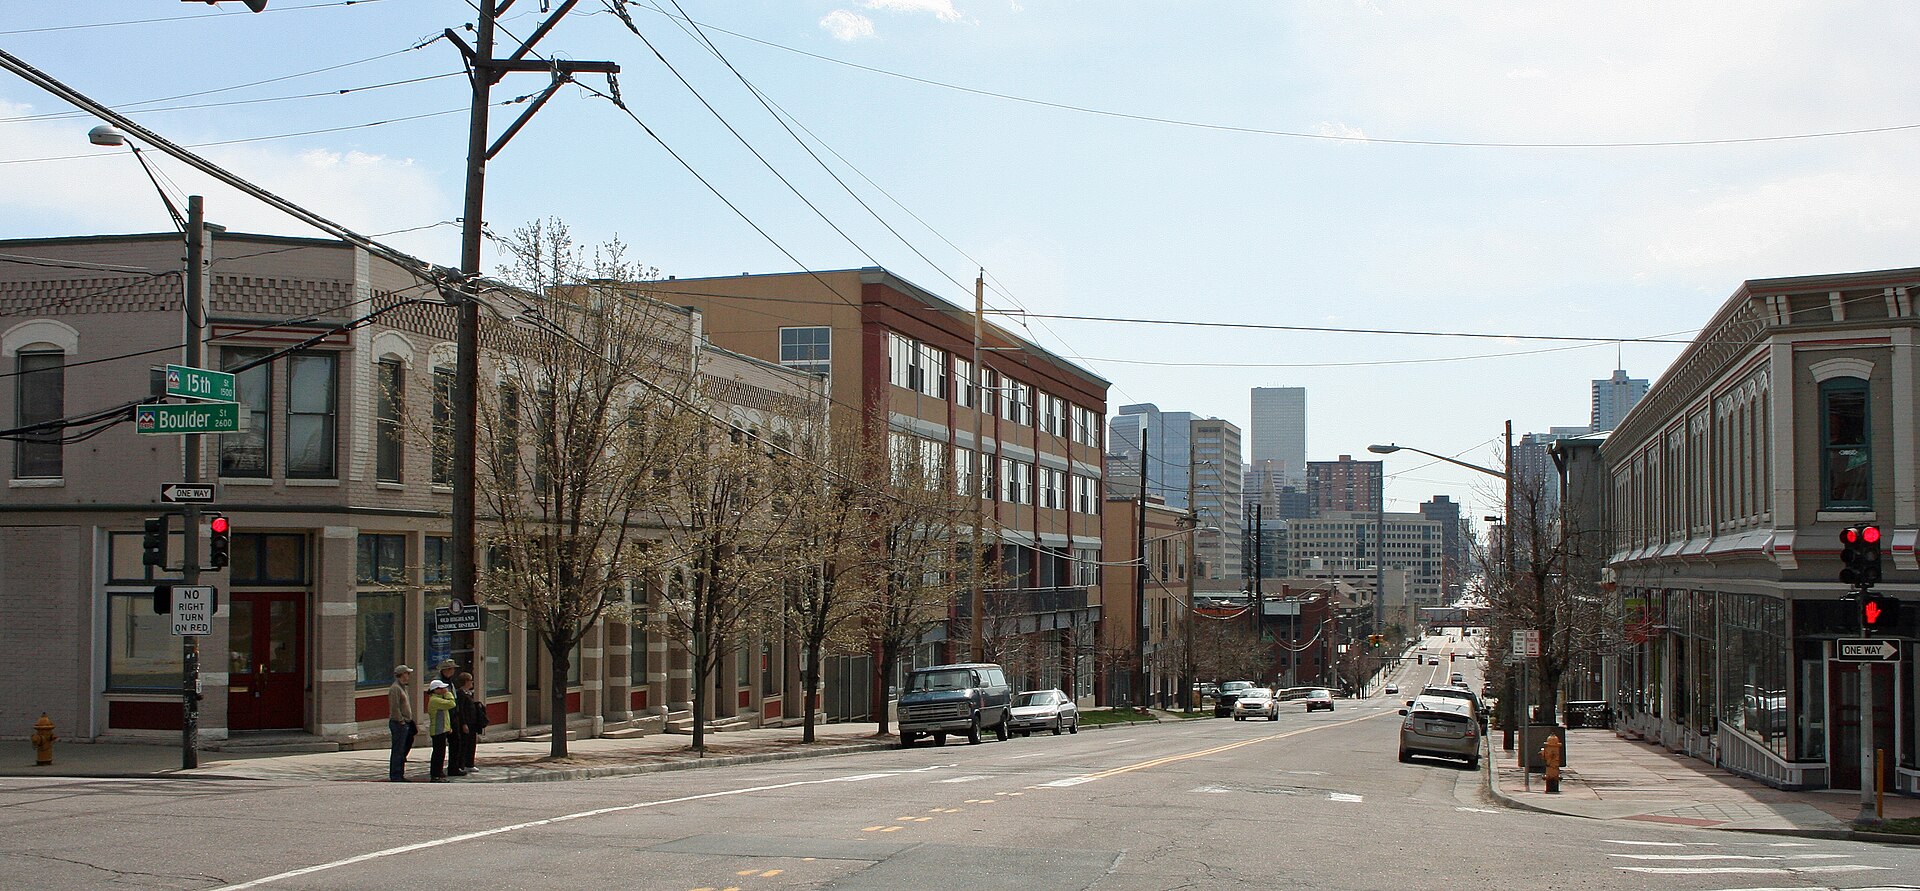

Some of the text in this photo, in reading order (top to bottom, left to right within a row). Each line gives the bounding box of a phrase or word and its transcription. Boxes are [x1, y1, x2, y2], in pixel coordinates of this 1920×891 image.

[187, 373, 211, 394] 15th
[223, 379, 229, 387] St
[220, 388, 232, 397] 1500
[160, 410, 210, 428] Boulder
[219, 409, 227, 417] St
[214, 419, 233, 428] 2600
[177, 489, 209, 497] ONE WAY
[184, 590, 199, 599] NO
[1844, 645, 1882, 655] ONE WAY
